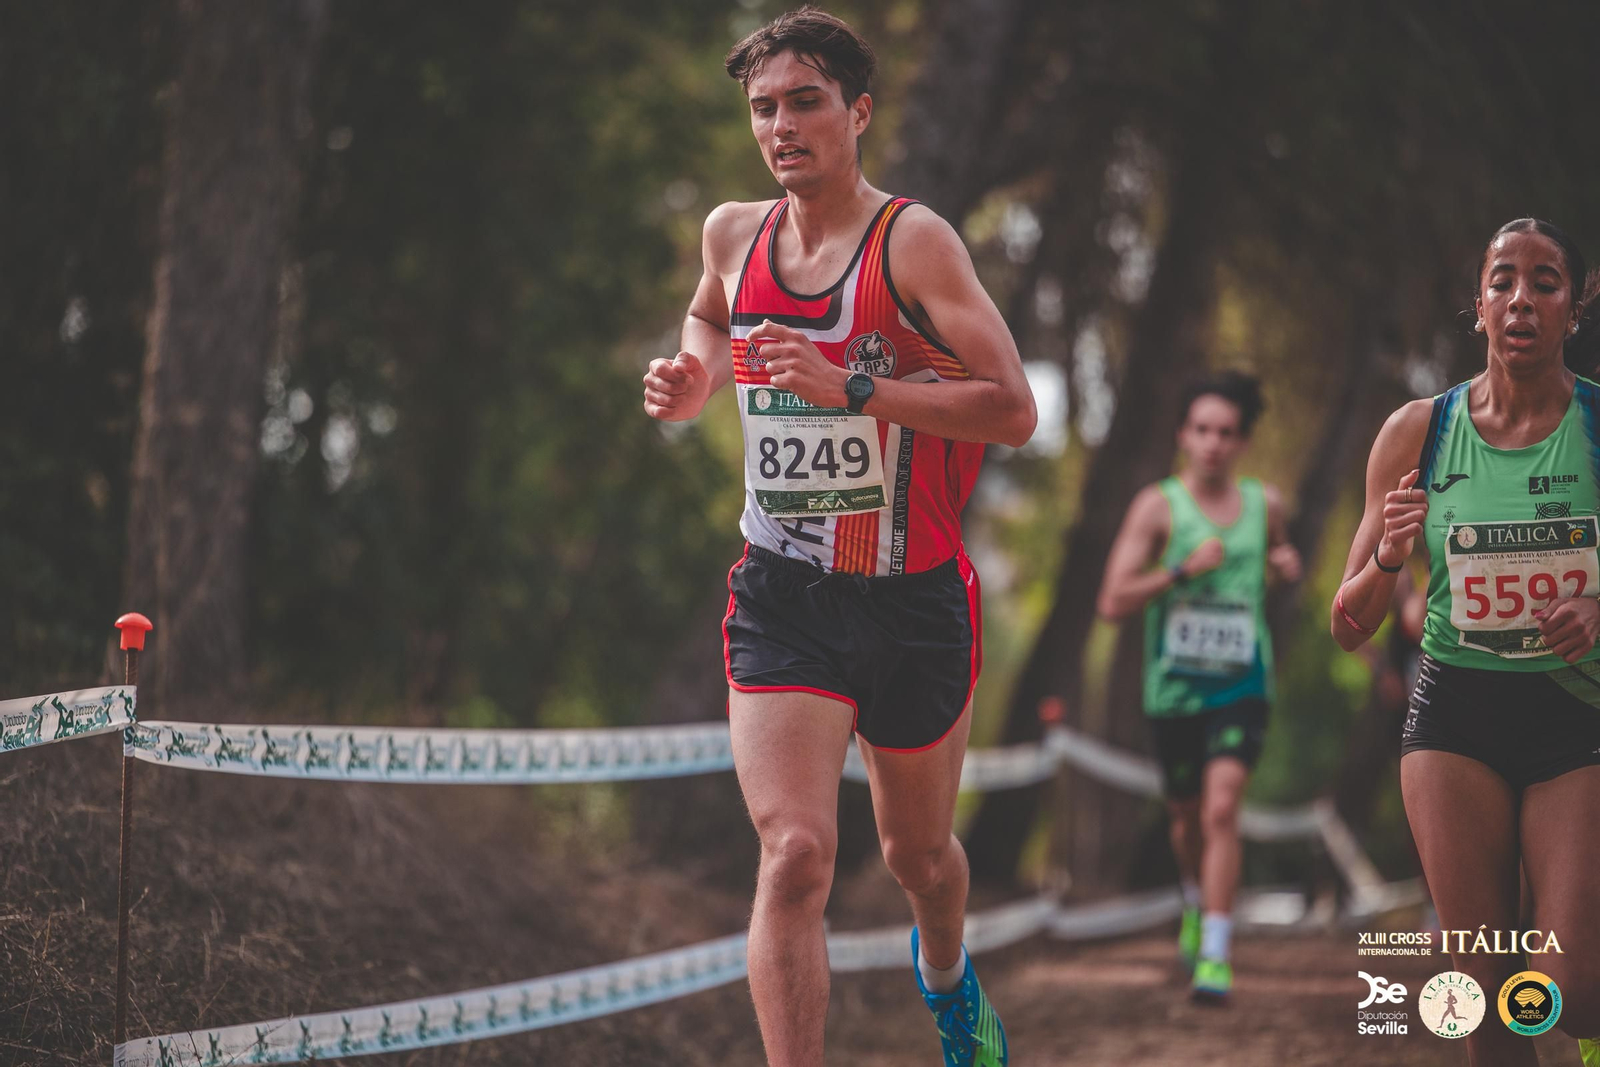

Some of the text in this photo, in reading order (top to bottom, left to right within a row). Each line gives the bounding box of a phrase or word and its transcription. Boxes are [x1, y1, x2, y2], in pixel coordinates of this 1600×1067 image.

[854, 359, 890, 373] CAPS
[760, 437, 870, 479] 8249
[898, 466, 909, 480] DE
[1551, 475, 1579, 483] ALEDE
[894, 480, 907, 512] POBLA
[894, 515, 906, 526] LA
[1487, 525, 1558, 543] ITÁLICA
[891, 529, 904, 577] LETISME
[1464, 569, 1588, 620] 5592
